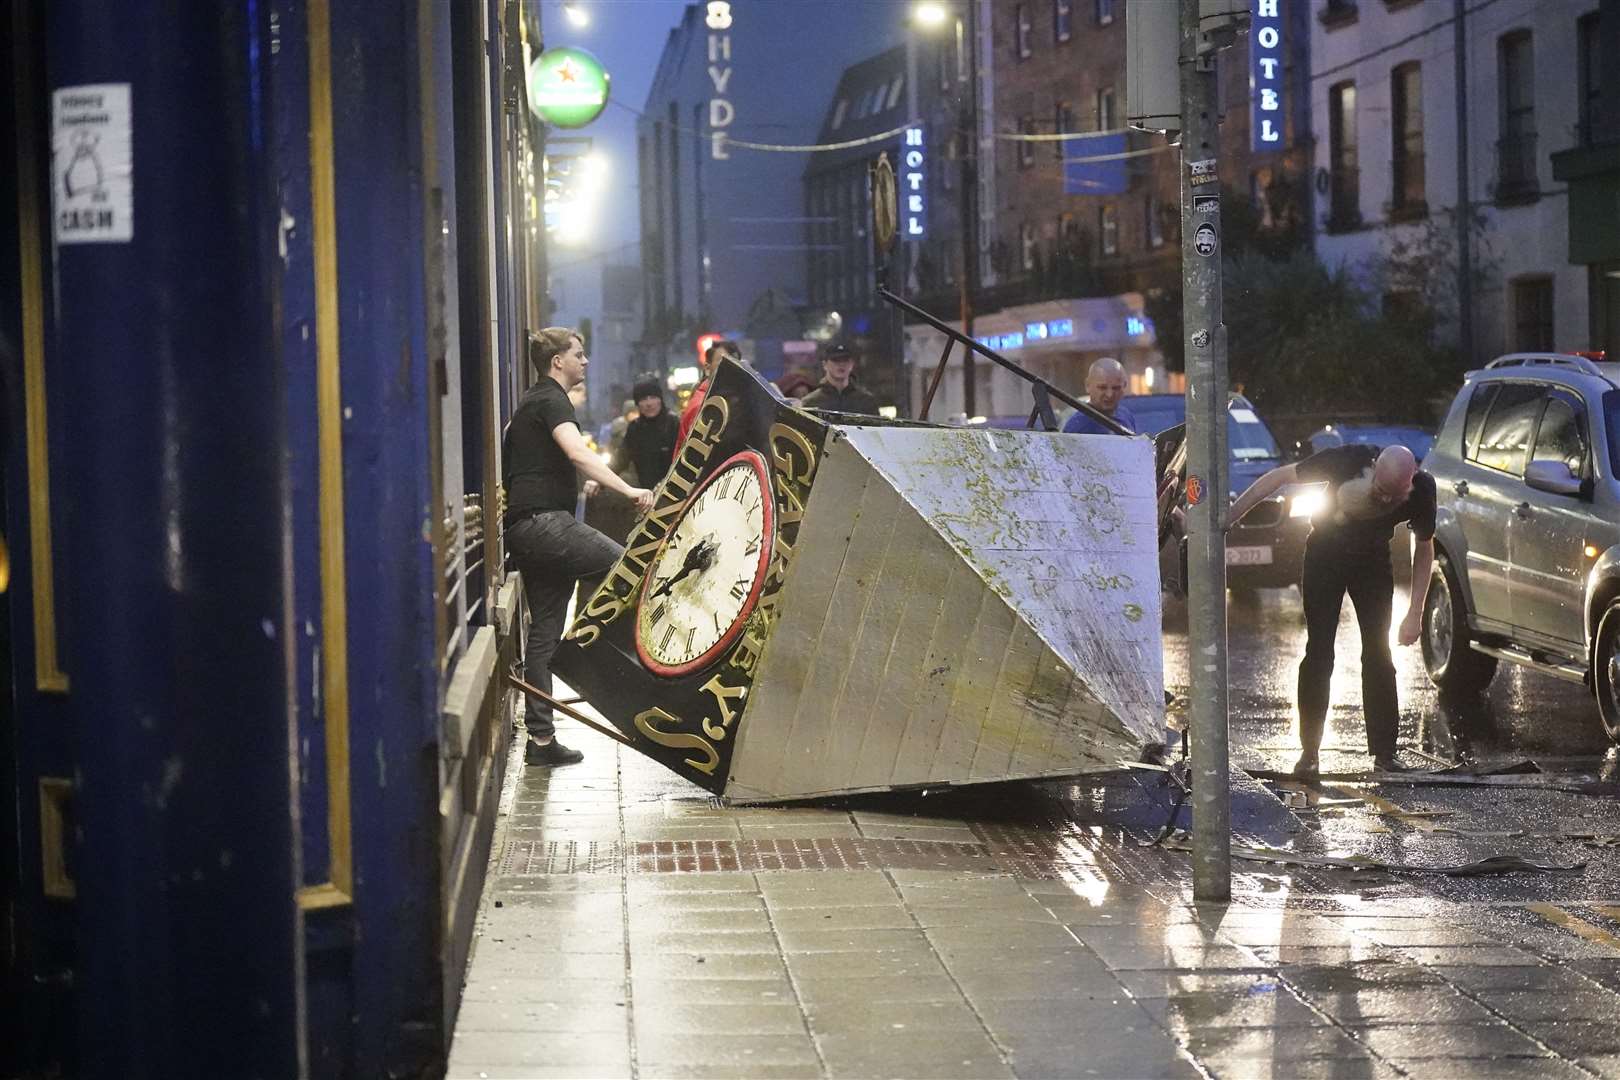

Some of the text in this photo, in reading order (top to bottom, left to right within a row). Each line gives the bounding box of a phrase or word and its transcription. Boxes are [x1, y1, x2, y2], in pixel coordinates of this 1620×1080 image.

[1258, 0, 1279, 141] HOTEL
[906, 128, 924, 235] HOTEL
[564, 396, 731, 649] GUINNESS
